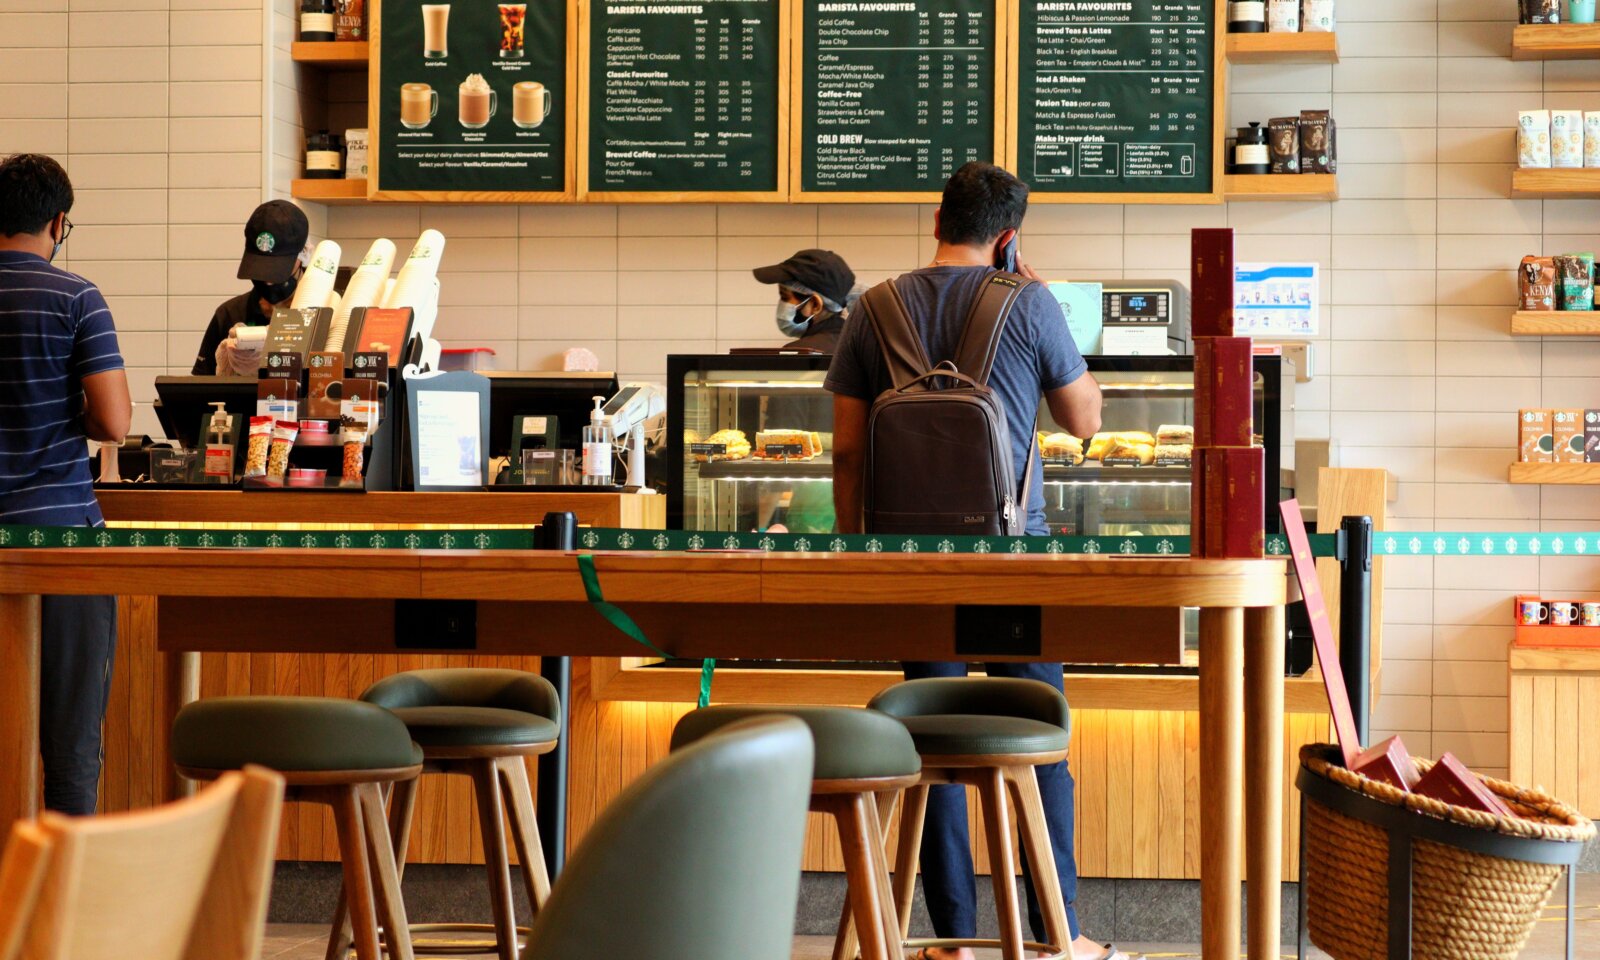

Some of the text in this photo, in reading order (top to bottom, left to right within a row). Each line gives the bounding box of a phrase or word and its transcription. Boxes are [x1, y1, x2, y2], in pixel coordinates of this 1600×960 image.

[607, 5, 703, 14] BARISTA FAVOURITES
[818, 3, 916, 12] BARISTA FAVOURITES
[1036, 3, 1132, 11] BARISTA FAVOURITES
[340, 16, 361, 27] KENYA
[817, 134, 838, 144] COLD
[840, 134, 863, 144] BREW
[1530, 284, 1553, 296] KENYA
[367, 356, 377, 364] VIA
